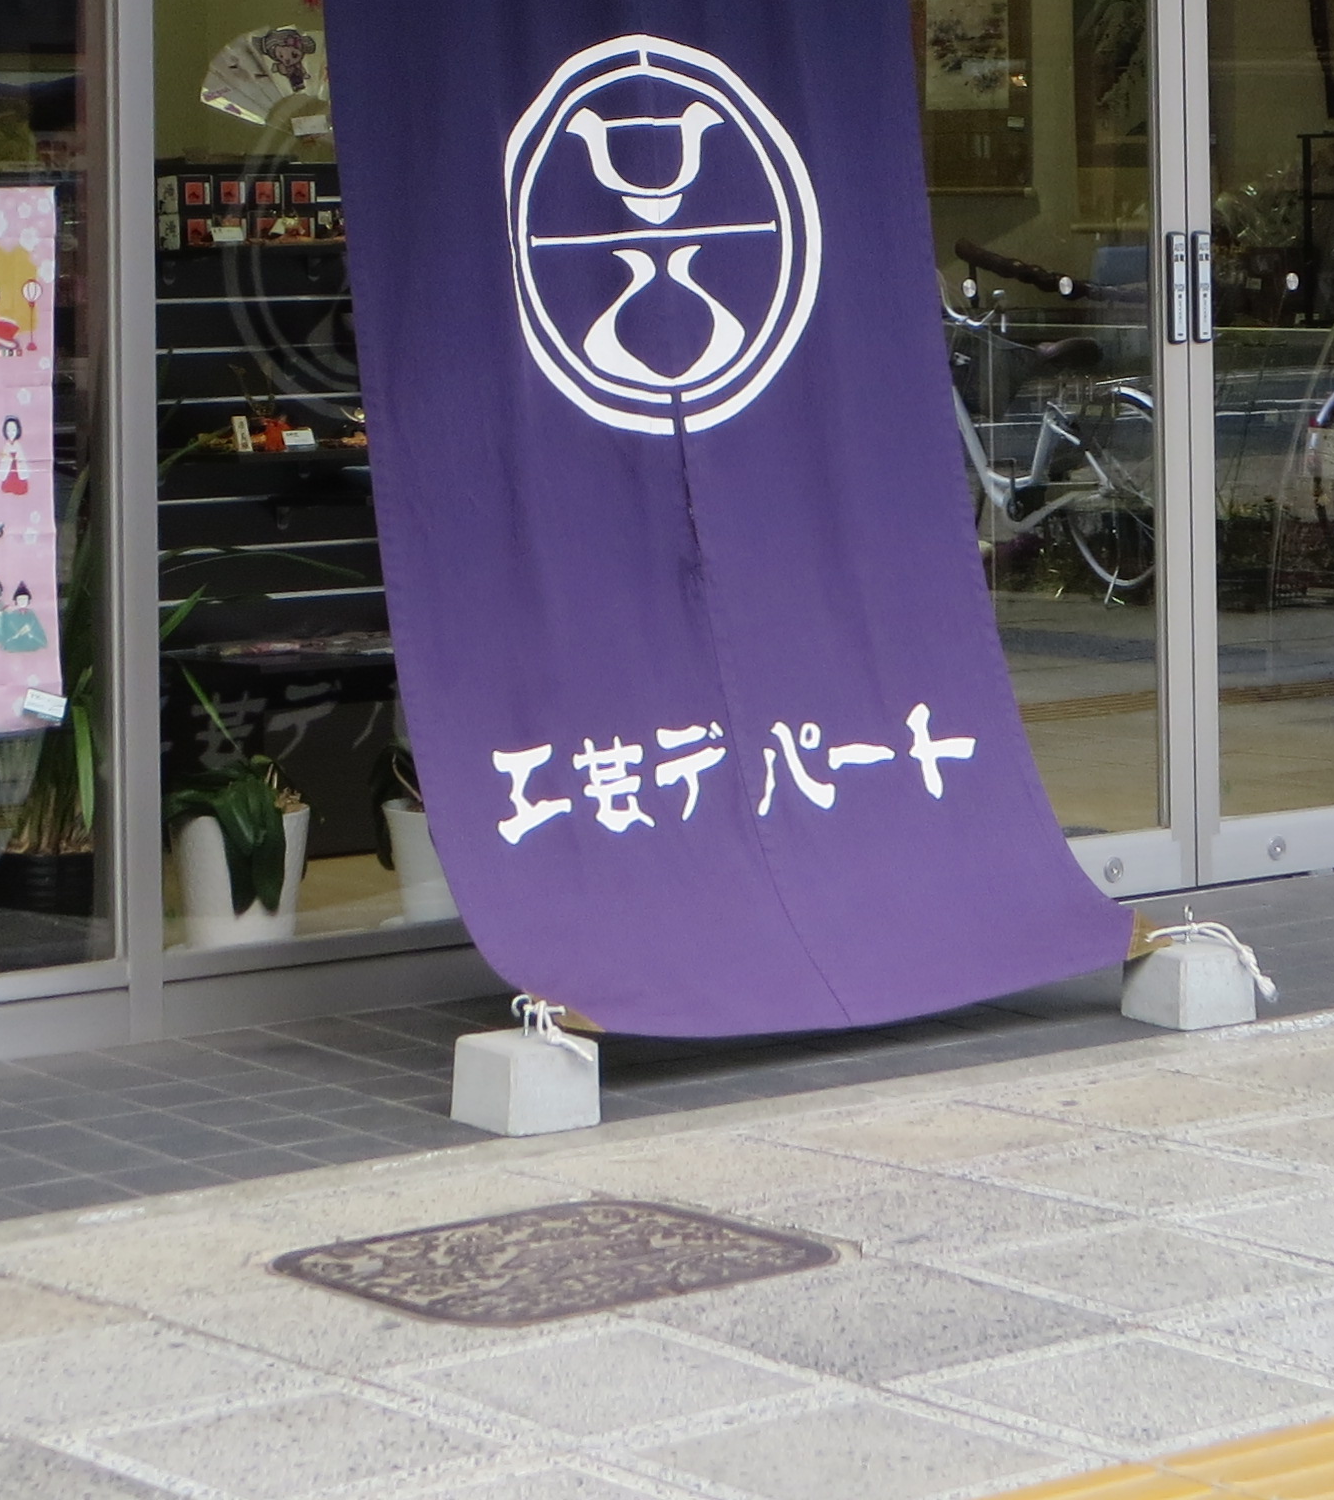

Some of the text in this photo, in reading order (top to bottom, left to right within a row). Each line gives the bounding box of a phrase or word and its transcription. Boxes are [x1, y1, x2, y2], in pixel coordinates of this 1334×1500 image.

[492, 702, 976, 845] 工芸デパート
